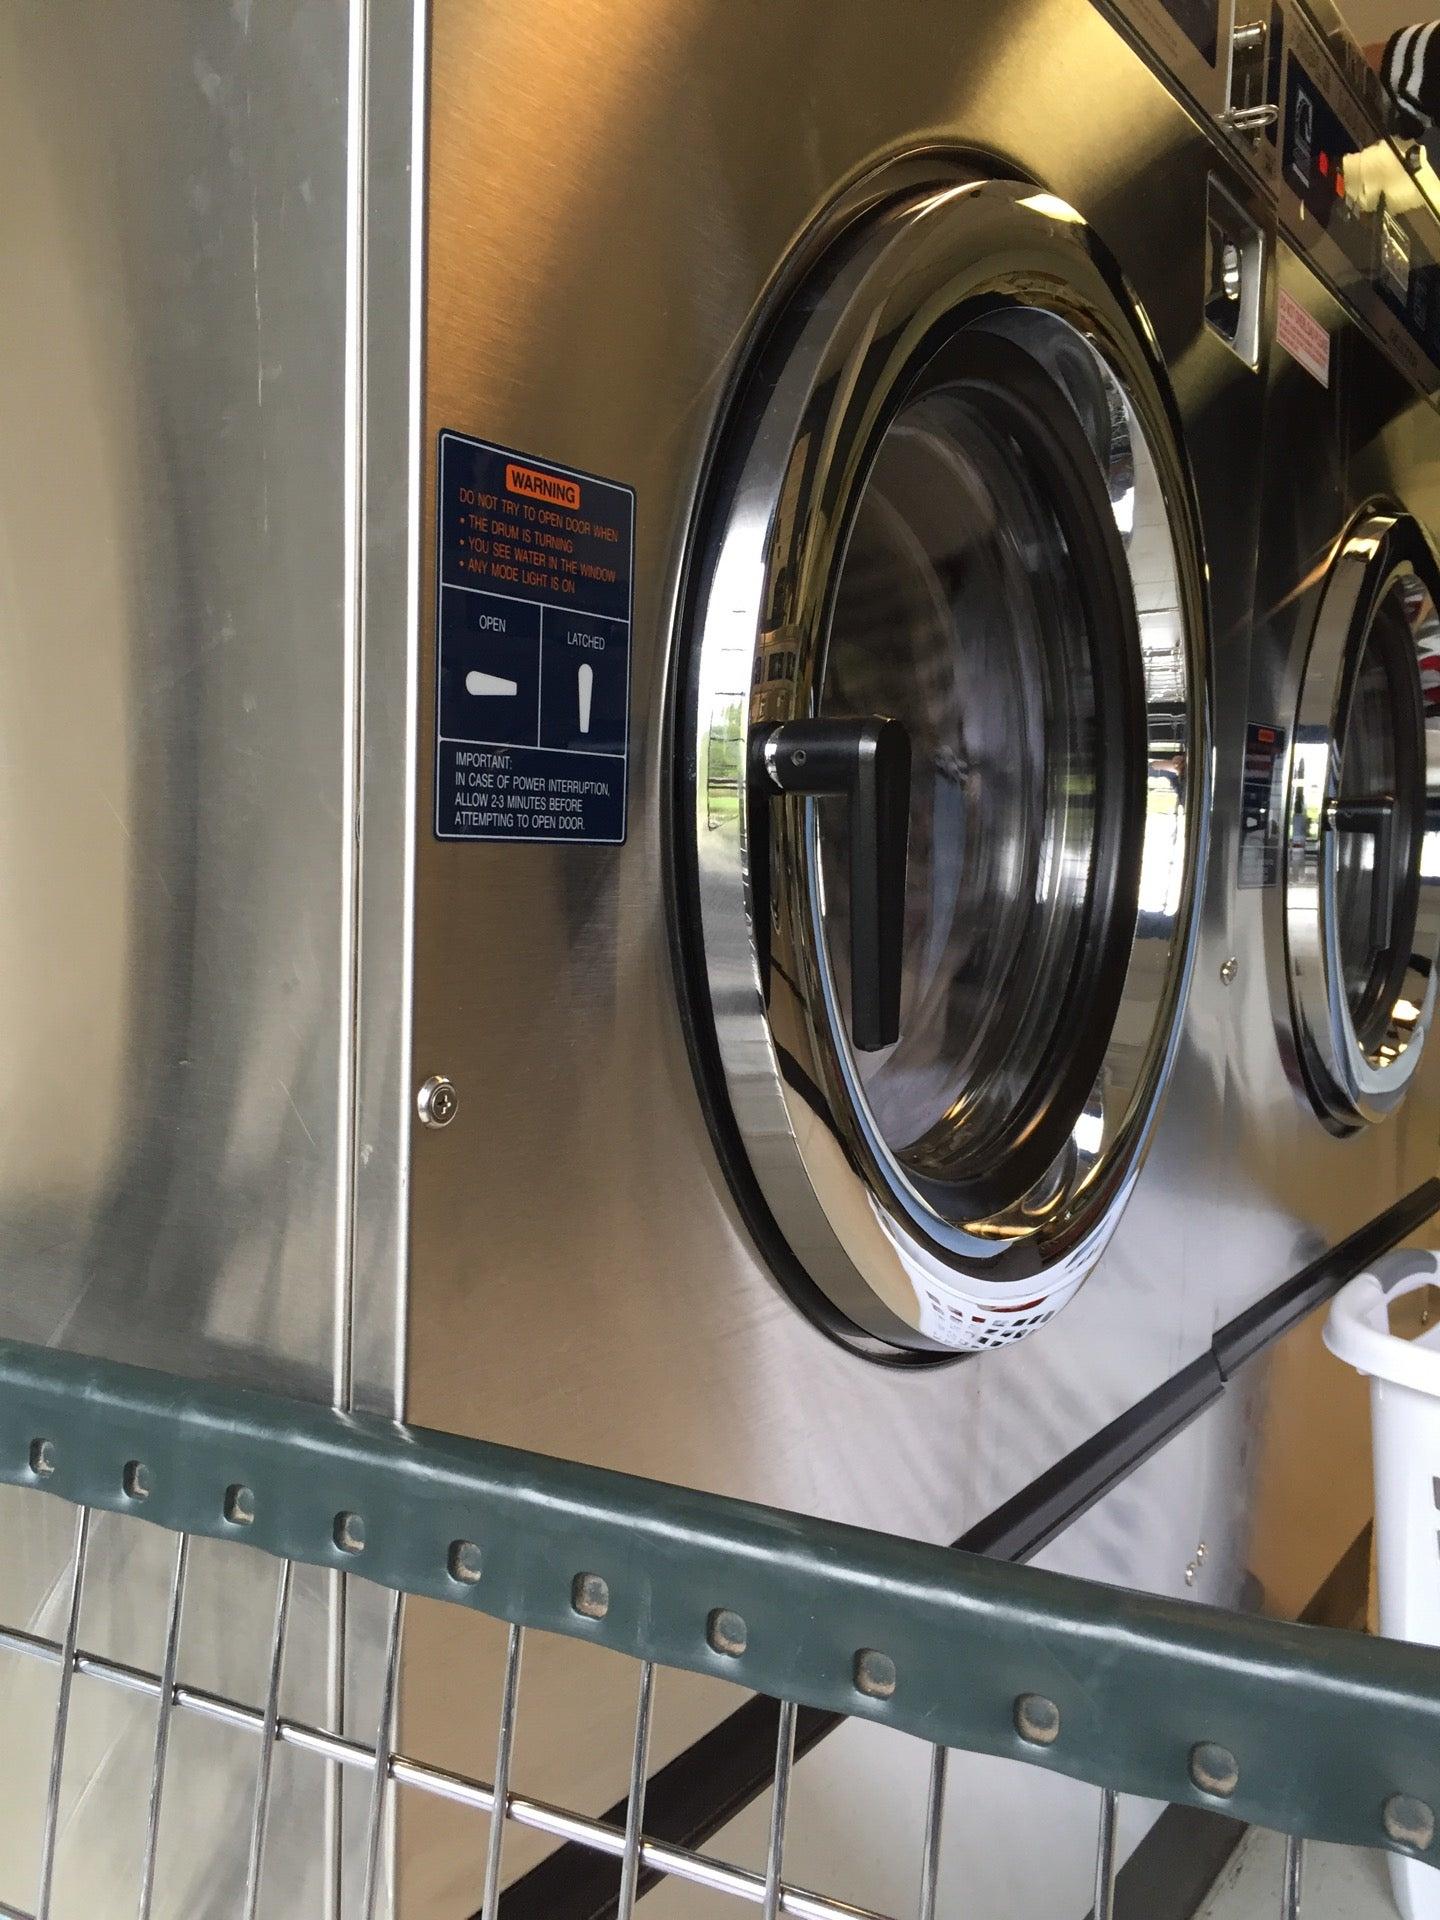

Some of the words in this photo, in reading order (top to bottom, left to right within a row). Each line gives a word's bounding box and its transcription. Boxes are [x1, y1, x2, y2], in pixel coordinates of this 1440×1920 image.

[512, 470, 575, 503] WARNING
[460, 488, 474, 504] DO
[479, 493, 497, 510] NOT
[502, 500, 519, 515] TRY
[524, 505, 535, 520] TO
[539, 509, 563, 528] OPEN
[566, 517, 591, 535] DOOR
[593, 525, 618, 542] WHEN
[469, 514, 488, 532] THE
[492, 520, 518, 539] DRUM
[523, 528, 531, 542] IS
[535, 531, 573, 553] TURNING
[469, 538, 488, 554] YOU
[493, 543, 510, 559] SEE
[515, 548, 545, 567] WATER
[549, 556, 557, 570] IN
[560, 558, 577, 574] THE
[580, 563, 616, 583] WINDOW
[468, 559, 488, 573] ANY
[492, 563, 518, 582] MODE
[523, 570, 548, 587] LIGHT
[551, 576, 559, 590] IS
[562, 578, 575, 593] ON
[479, 615, 506, 632] OPEN
[567, 632, 605, 650] LATCHED
[456, 752, 512, 769] IMPORTANT:
[456, 772, 465, 785] IN
[469, 773, 493, 788] CASE
[497, 775, 510, 788] OF
[513, 776, 545, 791] POWER
[455, 792, 488, 807] ALLOW
[491, 795, 504, 808] 2-3
[507, 796, 546, 810] MINUTES
[549, 798, 583, 812] BEFORE
[455, 812, 513, 827] ATTEMPTING
[517, 814, 528, 827] TO
[532, 815, 556, 828] OPEN
[559, 816, 585, 830] DOOR.
